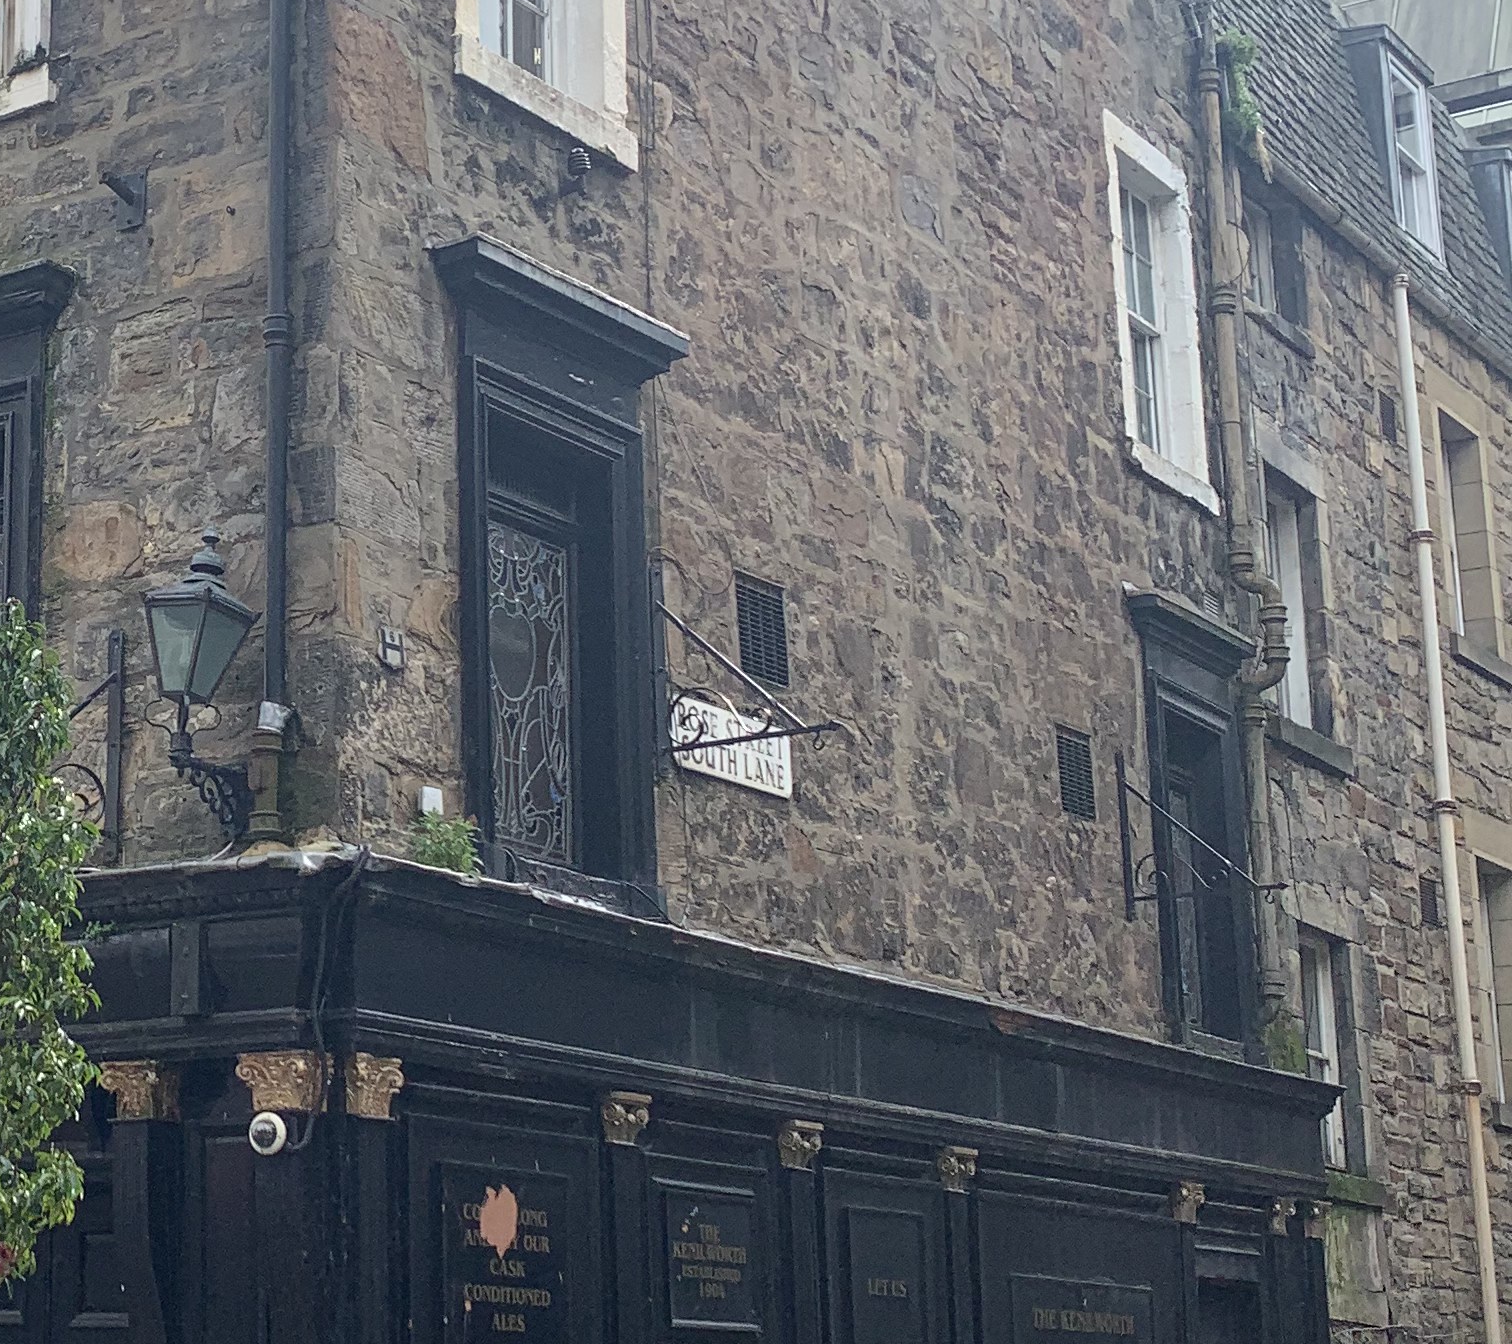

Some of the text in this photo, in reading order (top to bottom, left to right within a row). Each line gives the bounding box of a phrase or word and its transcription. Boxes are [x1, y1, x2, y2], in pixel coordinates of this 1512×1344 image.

[676, 702, 718, 739] ROSE
[680, 735, 785, 791] SOUTH LANE
[523, 1234, 550, 1254] OUR
[489, 1259, 525, 1278] CASK
[464, 1283, 551, 1308] CONDITIONED
[492, 1313, 526, 1333] ALES
